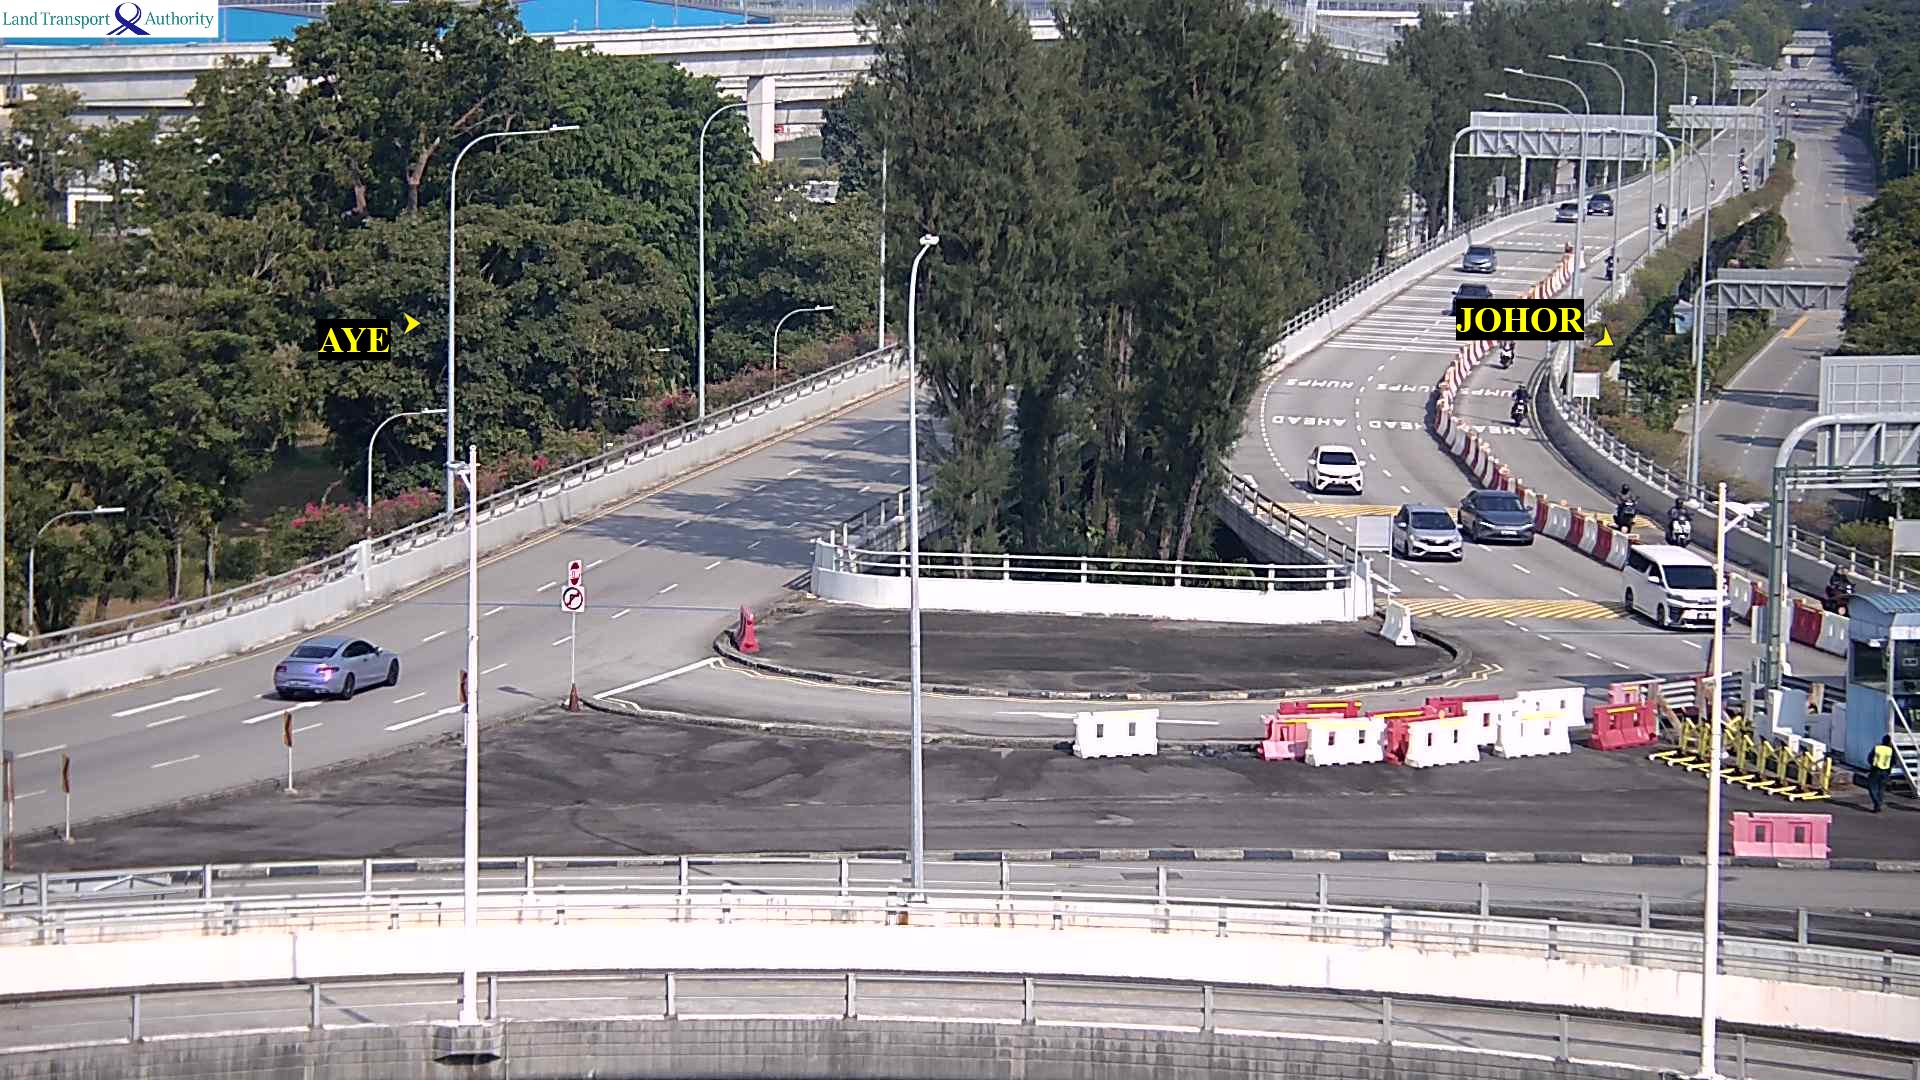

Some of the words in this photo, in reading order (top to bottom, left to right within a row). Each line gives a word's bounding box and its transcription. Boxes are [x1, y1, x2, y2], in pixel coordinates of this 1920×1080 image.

[1285, 378, 1354, 389] HUMPS
[1460, 387, 1514, 397] UMPS
[1271, 415, 1346, 427] AHEAD
